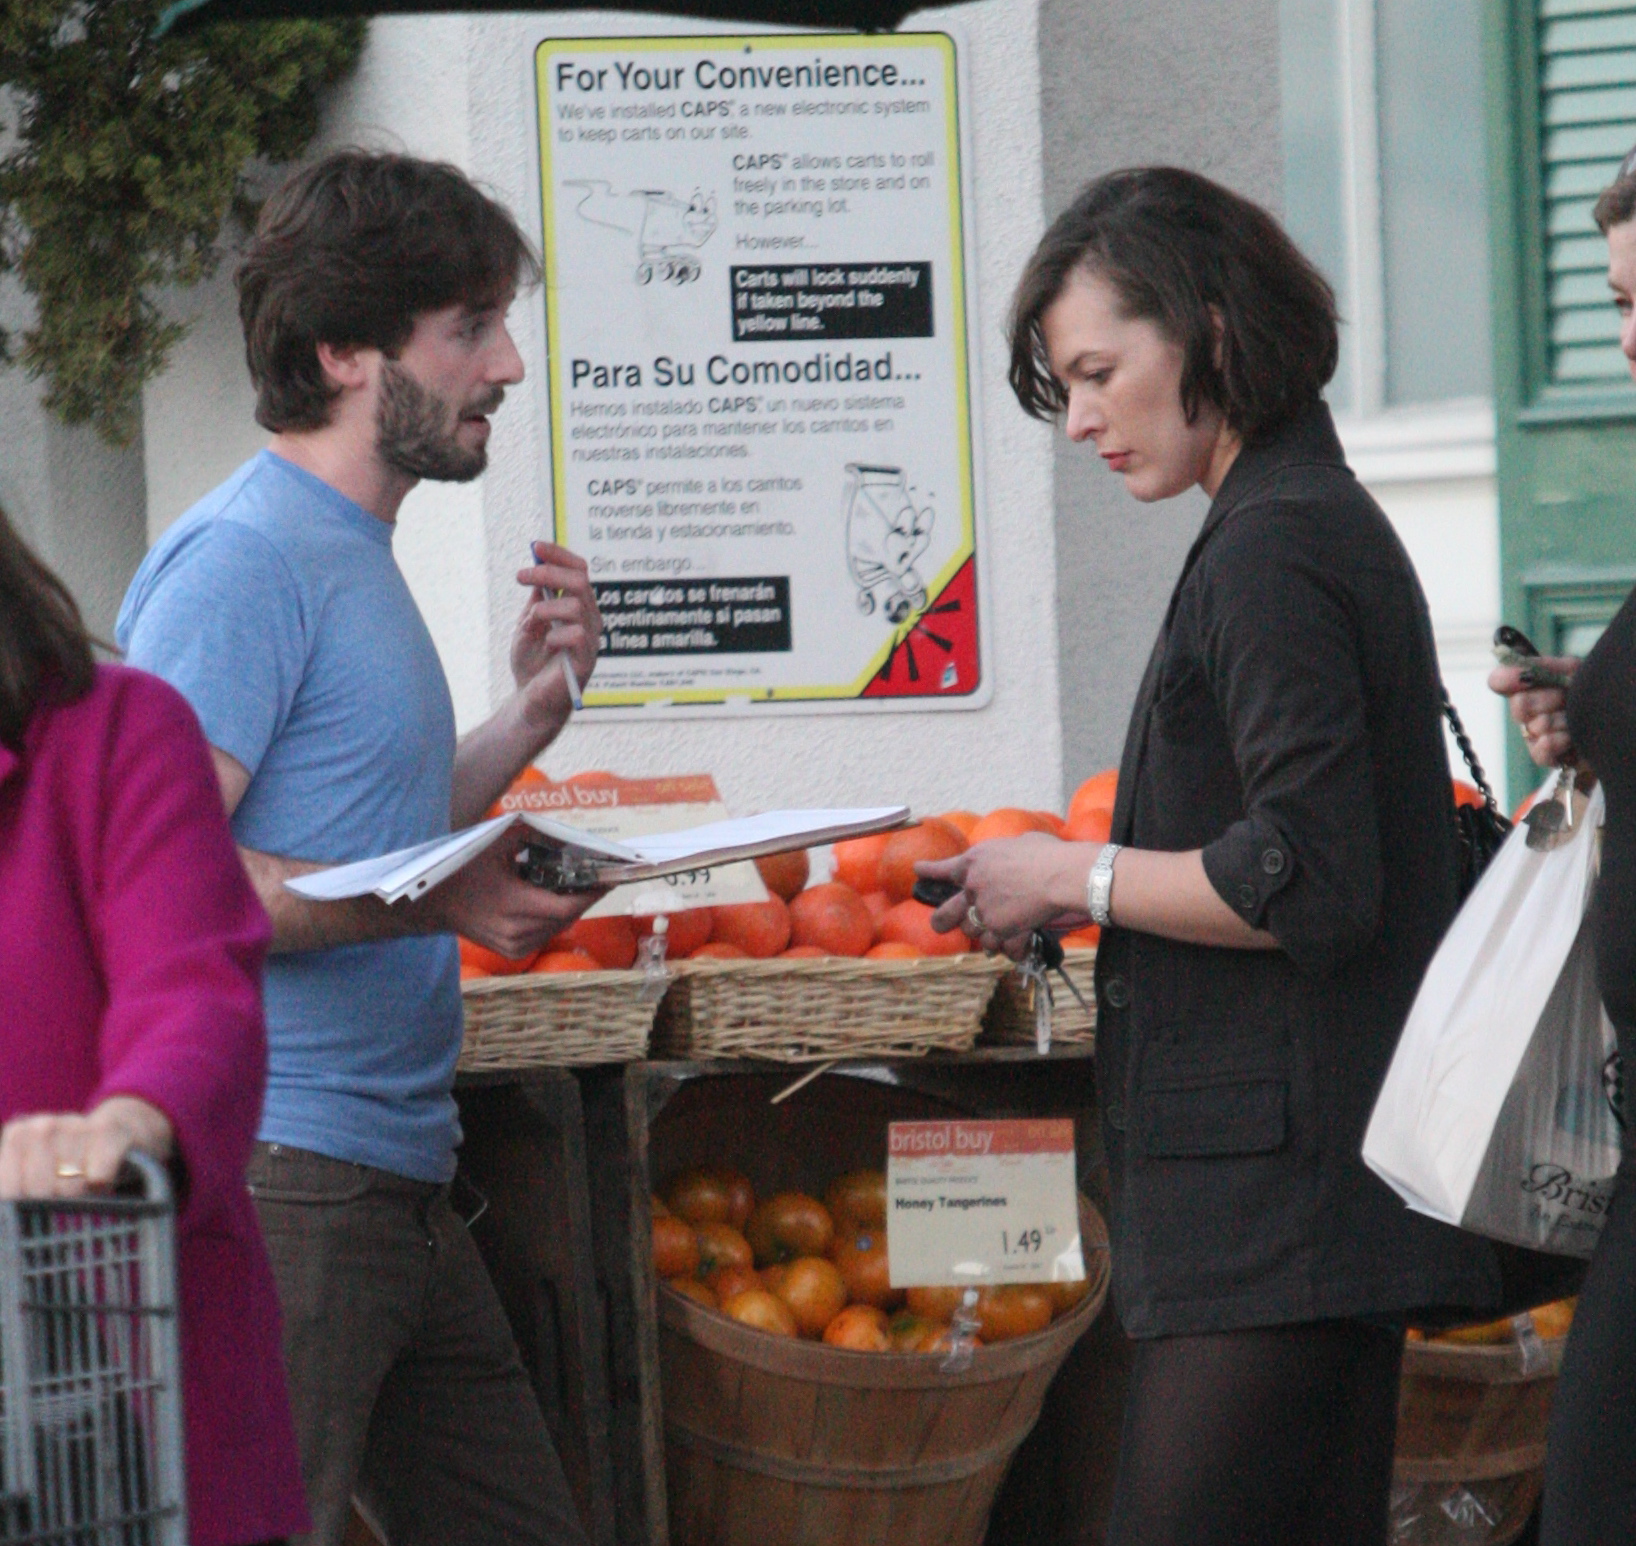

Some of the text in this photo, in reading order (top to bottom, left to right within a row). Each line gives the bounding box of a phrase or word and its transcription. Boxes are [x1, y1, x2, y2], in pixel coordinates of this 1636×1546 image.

[557, 58, 925, 92] For Your Convenience...
[558, 103, 605, 119] We've
[611, 102, 675, 119] installed
[740, 105, 749, 116] a
[754, 104, 786, 116] new
[792, 100, 869, 115] electronic
[874, 99, 931, 118] system
[558, 124, 753, 145] to keep carts on our site.
[792, 153, 843, 169] allows
[846, 153, 887, 168] carts
[890, 153, 906, 167] to
[911, 151, 935, 167] roll
[732, 174, 931, 197] freely in the store and on
[734, 200, 759, 216] the
[764, 199, 823, 218] parking
[735, 267, 921, 290] Carts will lock suddenly
[736, 289, 885, 312] if taken beyond the
[738, 313, 826, 336] yellow line.
[571, 351, 921, 389] Para Su Comodidad...
[570, 401, 627, 417] Hemos
[631, 399, 703, 415] instalado
[766, 399, 787, 412] un
[791, 398, 839, 411] nuevo
[844, 395, 905, 410] sistema
[662, 423, 698, 440] para
[703, 419, 777, 436] mantener
[782, 418, 806, 434] los
[810, 417, 870, 433] carritos
[873, 418, 894, 432] en
[572, 445, 641, 462] nuestras
[646, 479, 704, 497] permite
[707, 480, 717, 494] a
[721, 477, 744, 493] los
[746, 476, 804, 492] carritos
[588, 500, 760, 518] moverse libremente en
[589, 524, 603, 540] la
[606, 523, 653, 539] tienda
[656, 525, 667, 543] y
[590, 555, 616, 574] Sin
[687, 587, 706, 602] se
[602, 608, 713, 632] pentinamente
[734, 607, 782, 628] pasan
[598, 633, 607, 650] a
[573, 784, 618, 807] buy
[890, 1126, 994, 1154] bristol buy
[1520, 1164, 1611, 1215] Bris
[896, 1196, 1007, 1212] Honey Tangerines
[1002, 1229, 1041, 1255] 1.49
